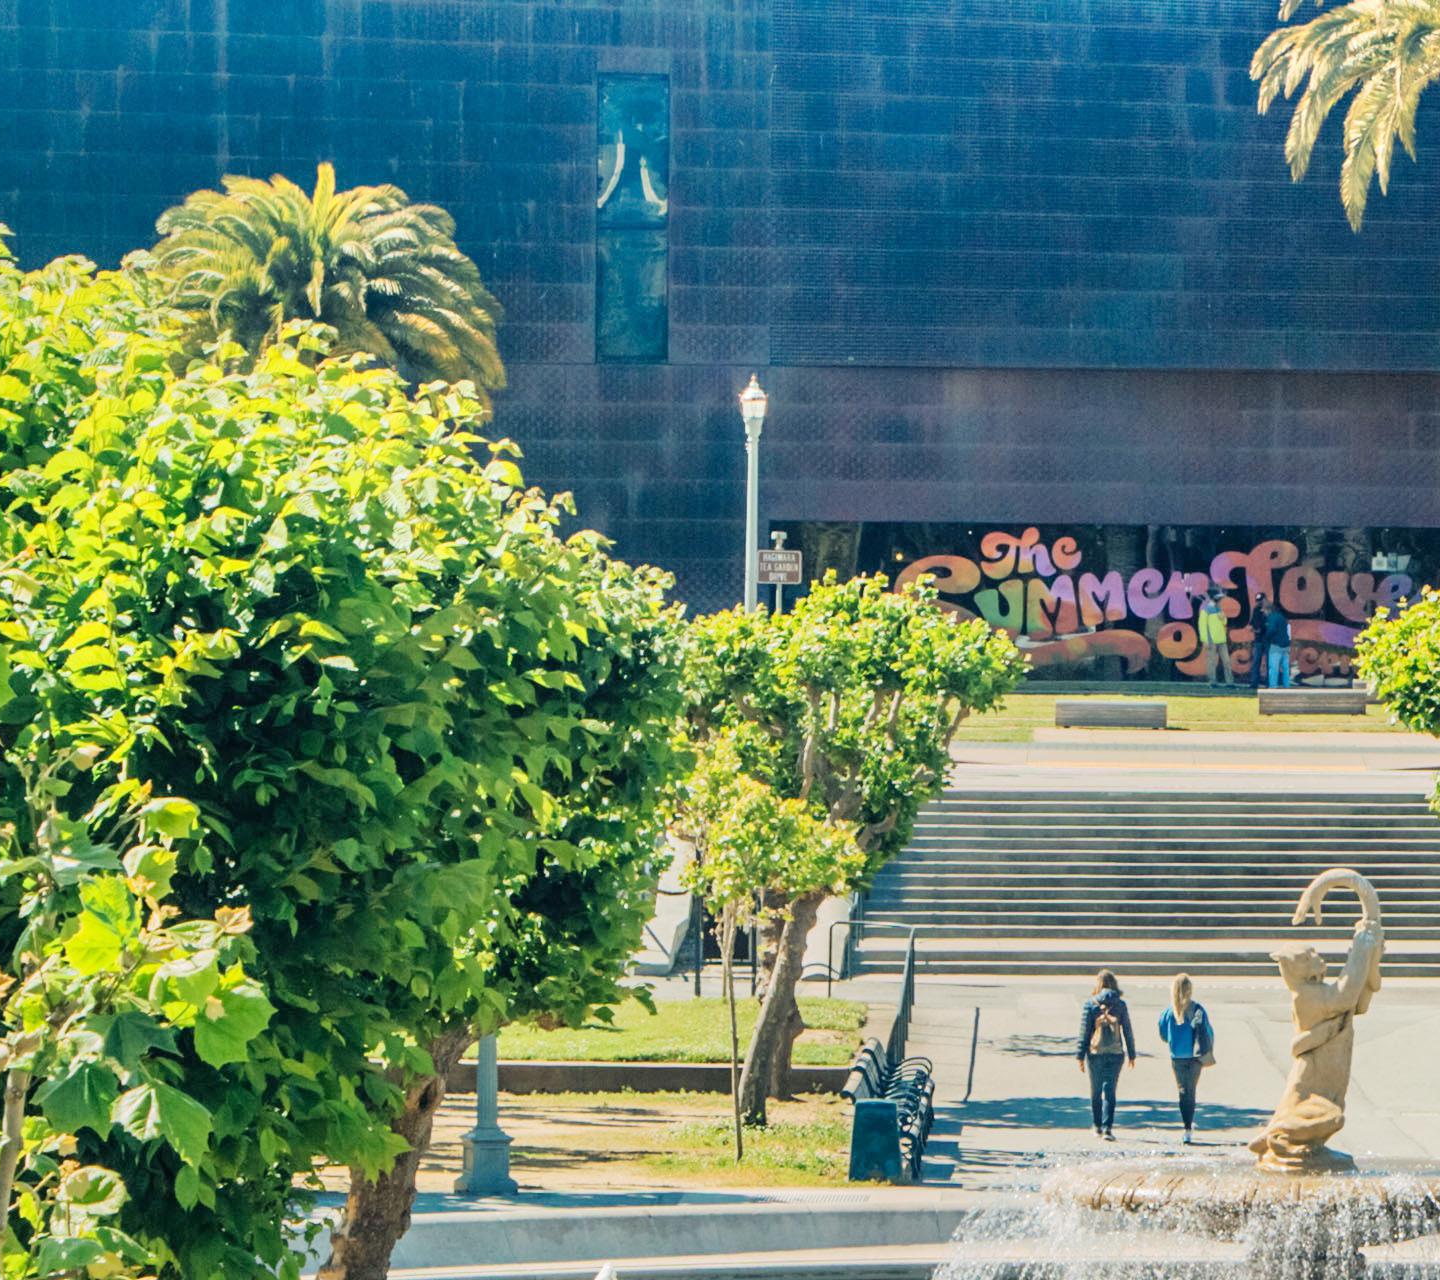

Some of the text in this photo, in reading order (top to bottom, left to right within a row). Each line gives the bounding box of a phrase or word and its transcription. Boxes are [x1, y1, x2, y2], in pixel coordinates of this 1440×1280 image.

[762, 553, 796, 562] HAGIWARA
[980, 526, 1082, 580] The
[759, 562, 799, 572] TEA GARDEN
[768, 572, 788, 582] DRIVE
